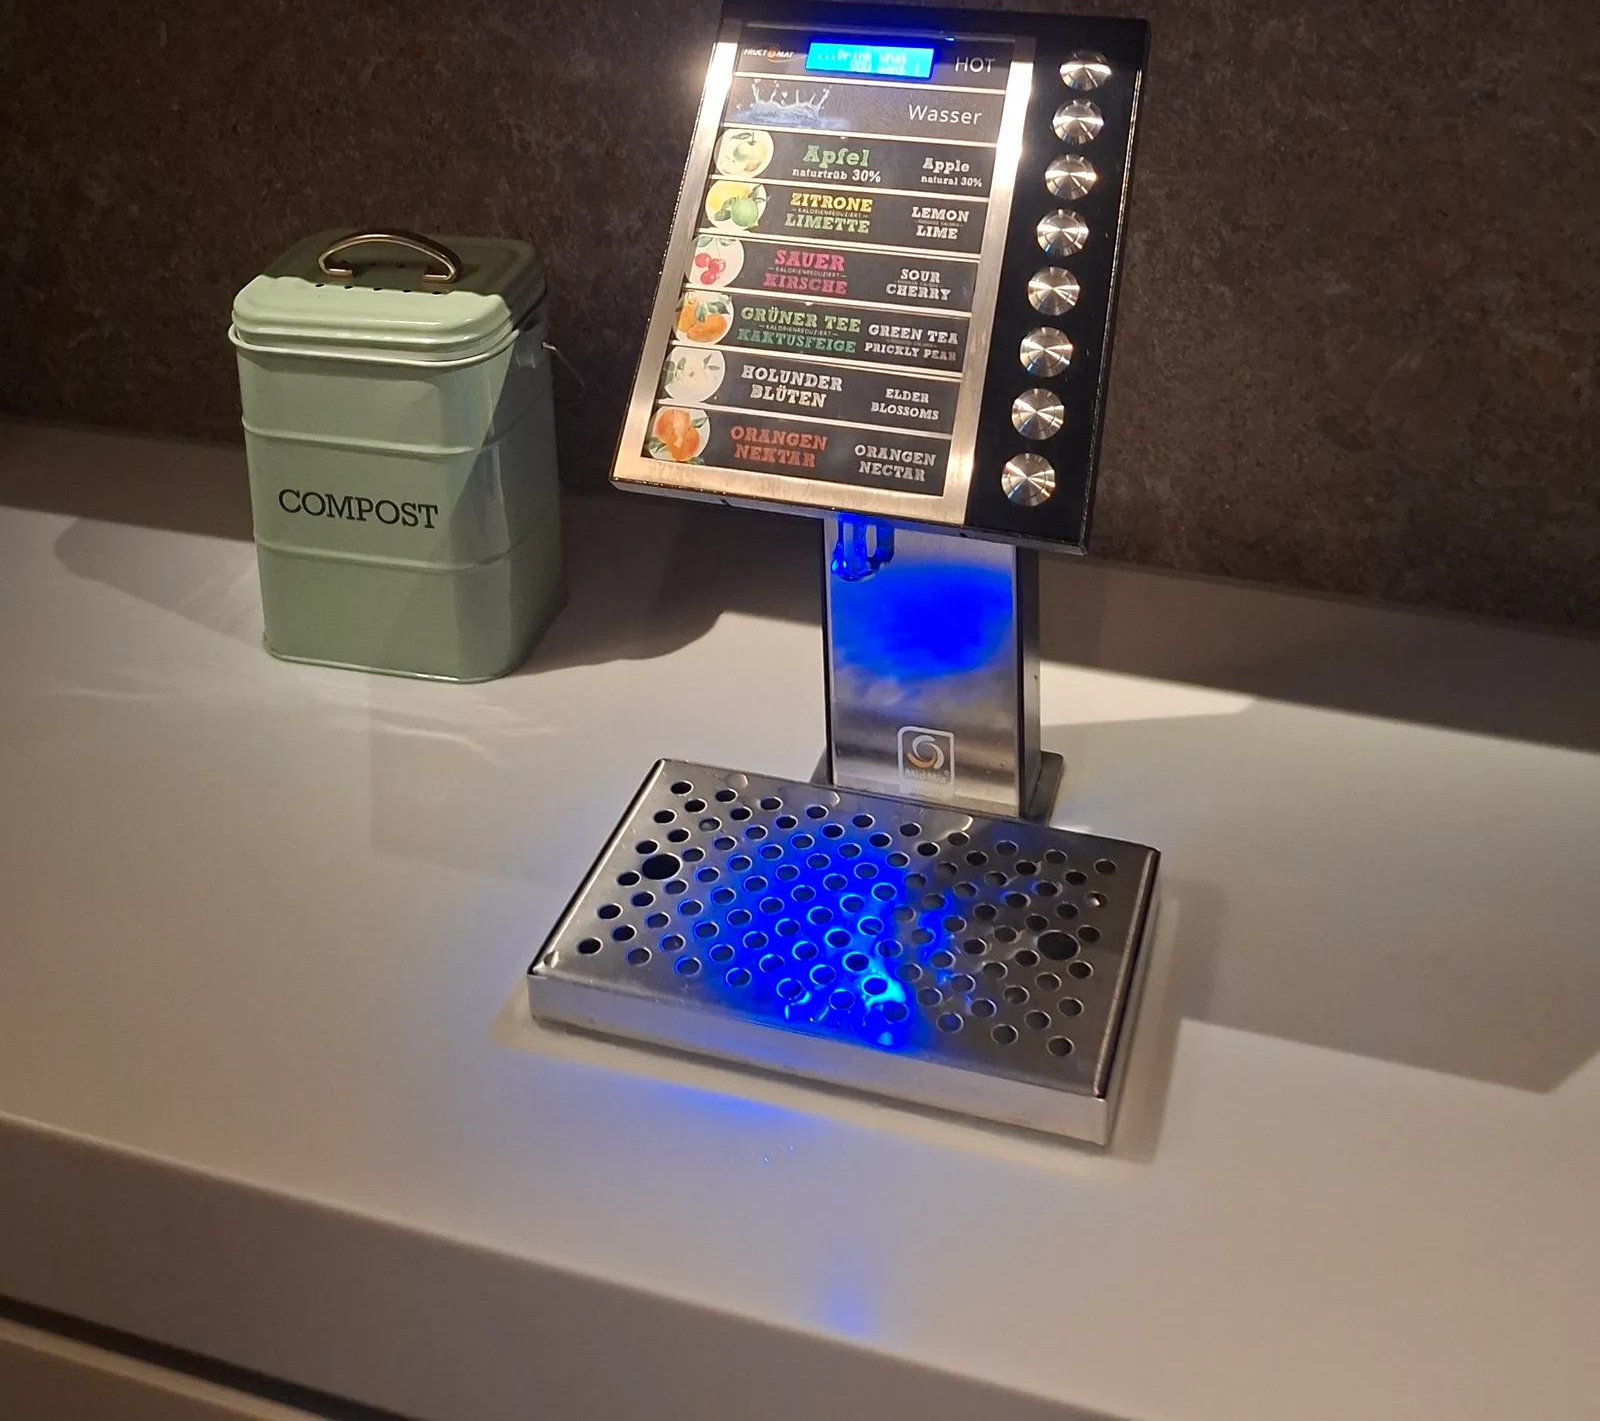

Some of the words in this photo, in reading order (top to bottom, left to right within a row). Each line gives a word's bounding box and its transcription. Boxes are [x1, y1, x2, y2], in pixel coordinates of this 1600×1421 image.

[954, 57, 996, 74] HOT
[908, 104, 982, 125] Wasser
[802, 145, 871, 168] Apfel
[922, 157, 970, 174] Apple
[792, 167, 848, 181] naturtrüb
[851, 169, 881, 183] 30%
[920, 175, 958, 186] natural
[960, 177, 983, 188] 30%
[790, 192, 874, 213] ZITRONE
[784, 212, 871, 235] LIMETTE
[911, 206, 970, 223] LEMON
[915, 224, 958, 240] LIME
[774, 249, 845, 272] SAUER
[763, 272, 848, 296] KIRSCHE
[900, 268, 941, 284] SOUR
[885, 283, 952, 301] CHERRY
[741, 305, 818, 329] GRÜNER
[824, 315, 862, 333] TEE
[737, 328, 857, 354] KAKTUSFEIGE
[868, 324, 924, 341] GREEN
[927, 329, 959, 345] TEA
[864, 342, 921, 359] PRICKLY
[923, 350, 957, 362] PEAR
[741, 365, 844, 392] HOLUNDER
[750, 384, 827, 409] BLÜTEN
[885, 388, 930, 404] ELDER
[870, 402, 939, 421] BLOSSOMS
[730, 426, 828, 451] ORANGEN
[734, 444, 817, 469] NEKTAR
[854, 445, 937, 467] ORANGEN
[858, 461, 926, 482] NECTAR
[278, 488, 439, 529] COMPOST
